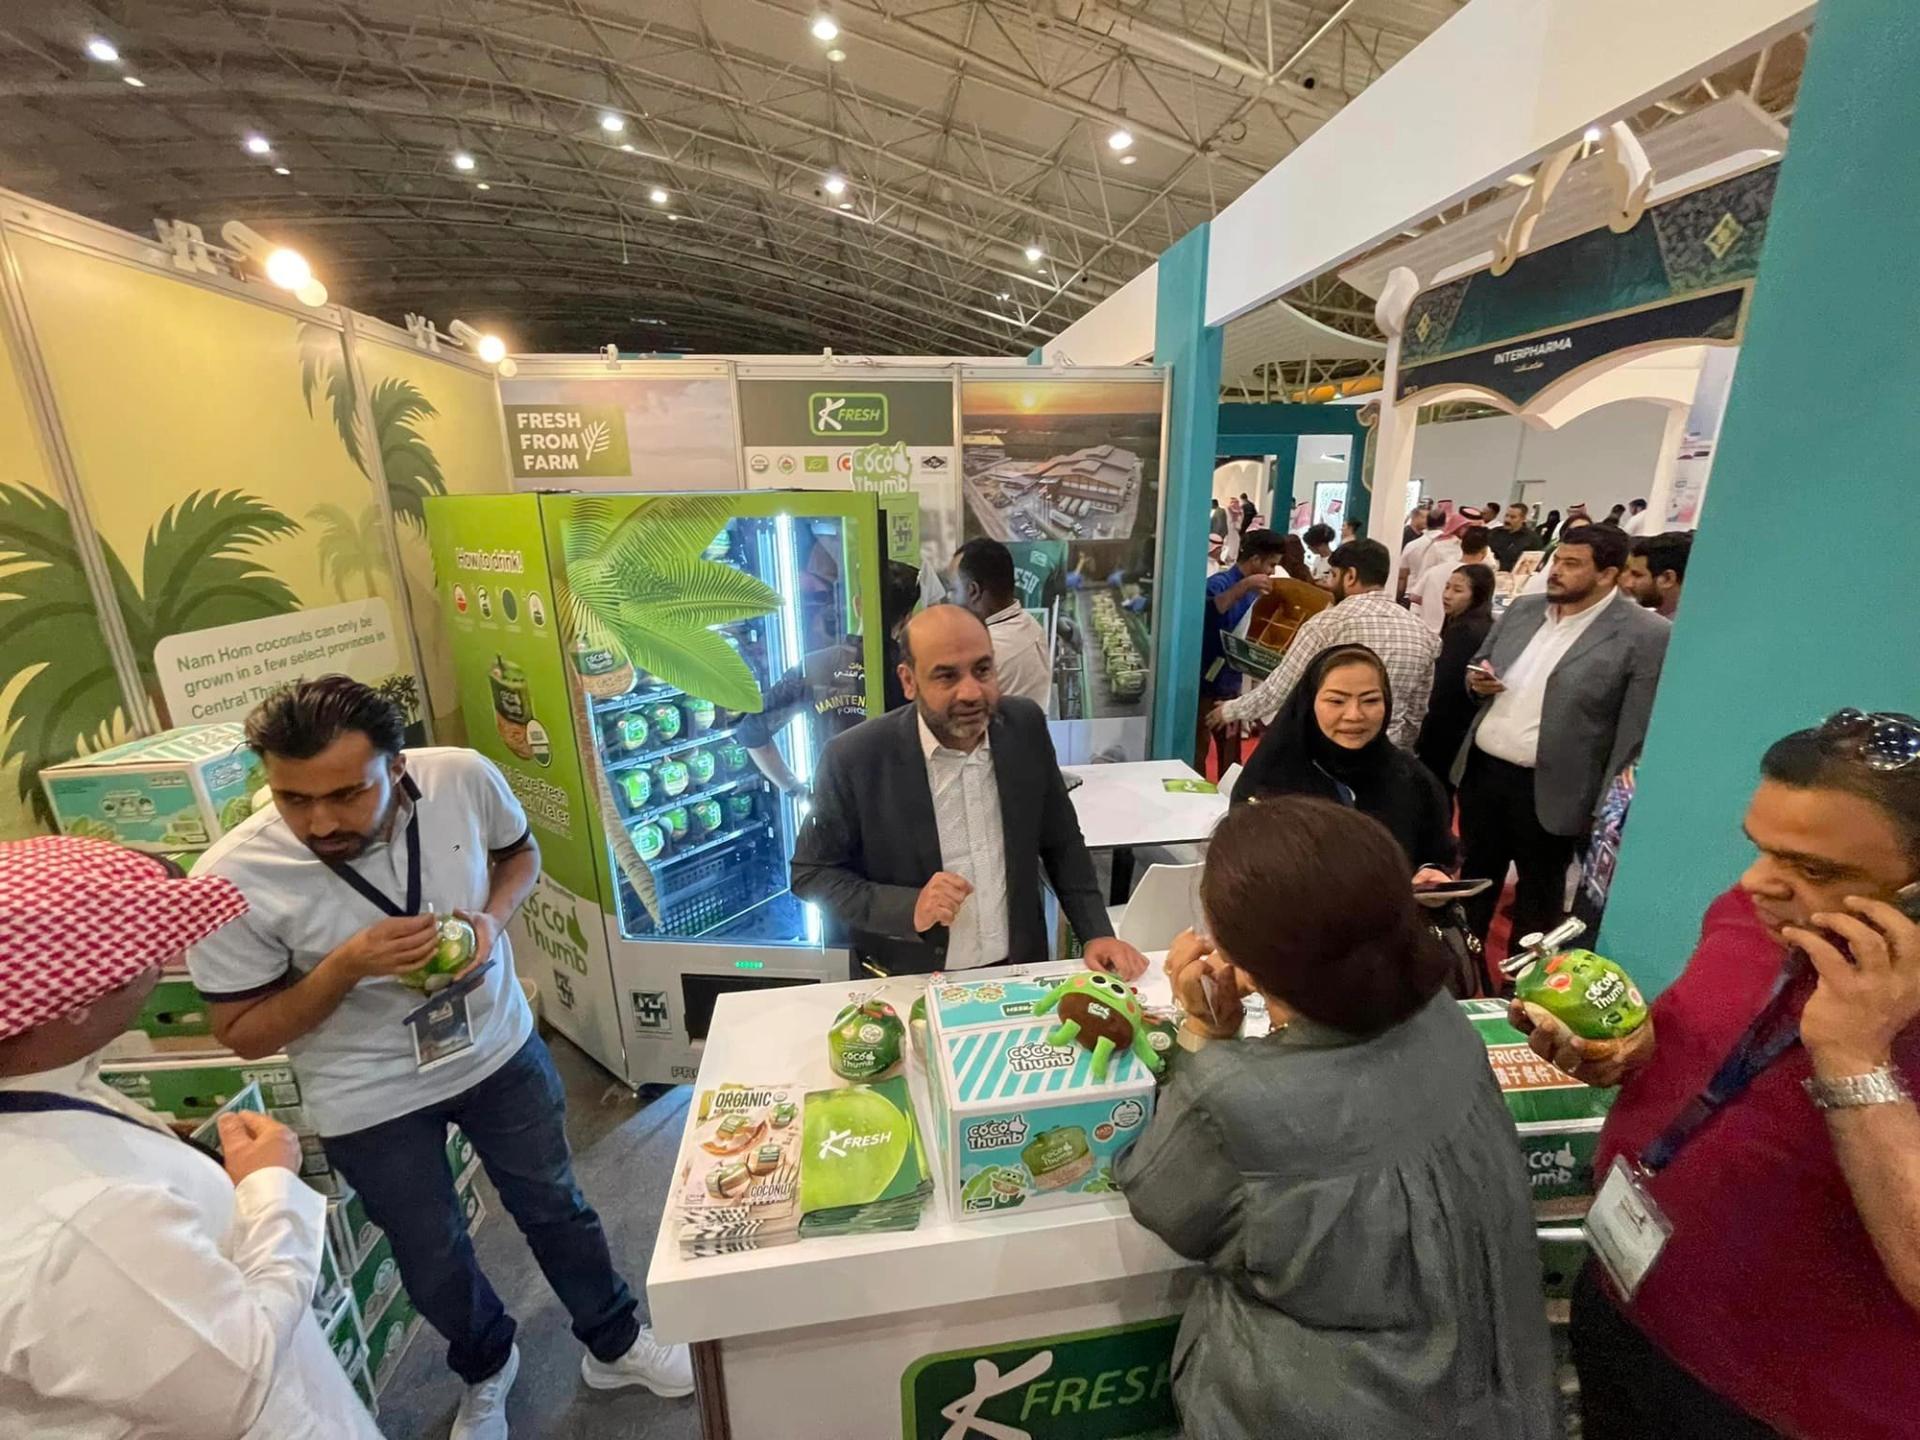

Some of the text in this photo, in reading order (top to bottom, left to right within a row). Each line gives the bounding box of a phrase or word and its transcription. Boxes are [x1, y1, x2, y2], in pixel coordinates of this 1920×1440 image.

[1494, 337, 1572, 365] INTERPHARMA
[516, 412, 582, 429] FRESH
[519, 433, 580, 450] FROM
[523, 454, 579, 470] FARM
[176, 616, 373, 673] Nam Hom coconuts can only be
[184, 631, 386, 698] grown in a few select provinces in
[191, 690, 249, 721] Central
[815, 694, 868, 714] MAINTEN
[715, 1091, 772, 1108] ORGANIC
[751, 1183, 792, 1198] COCONUT
